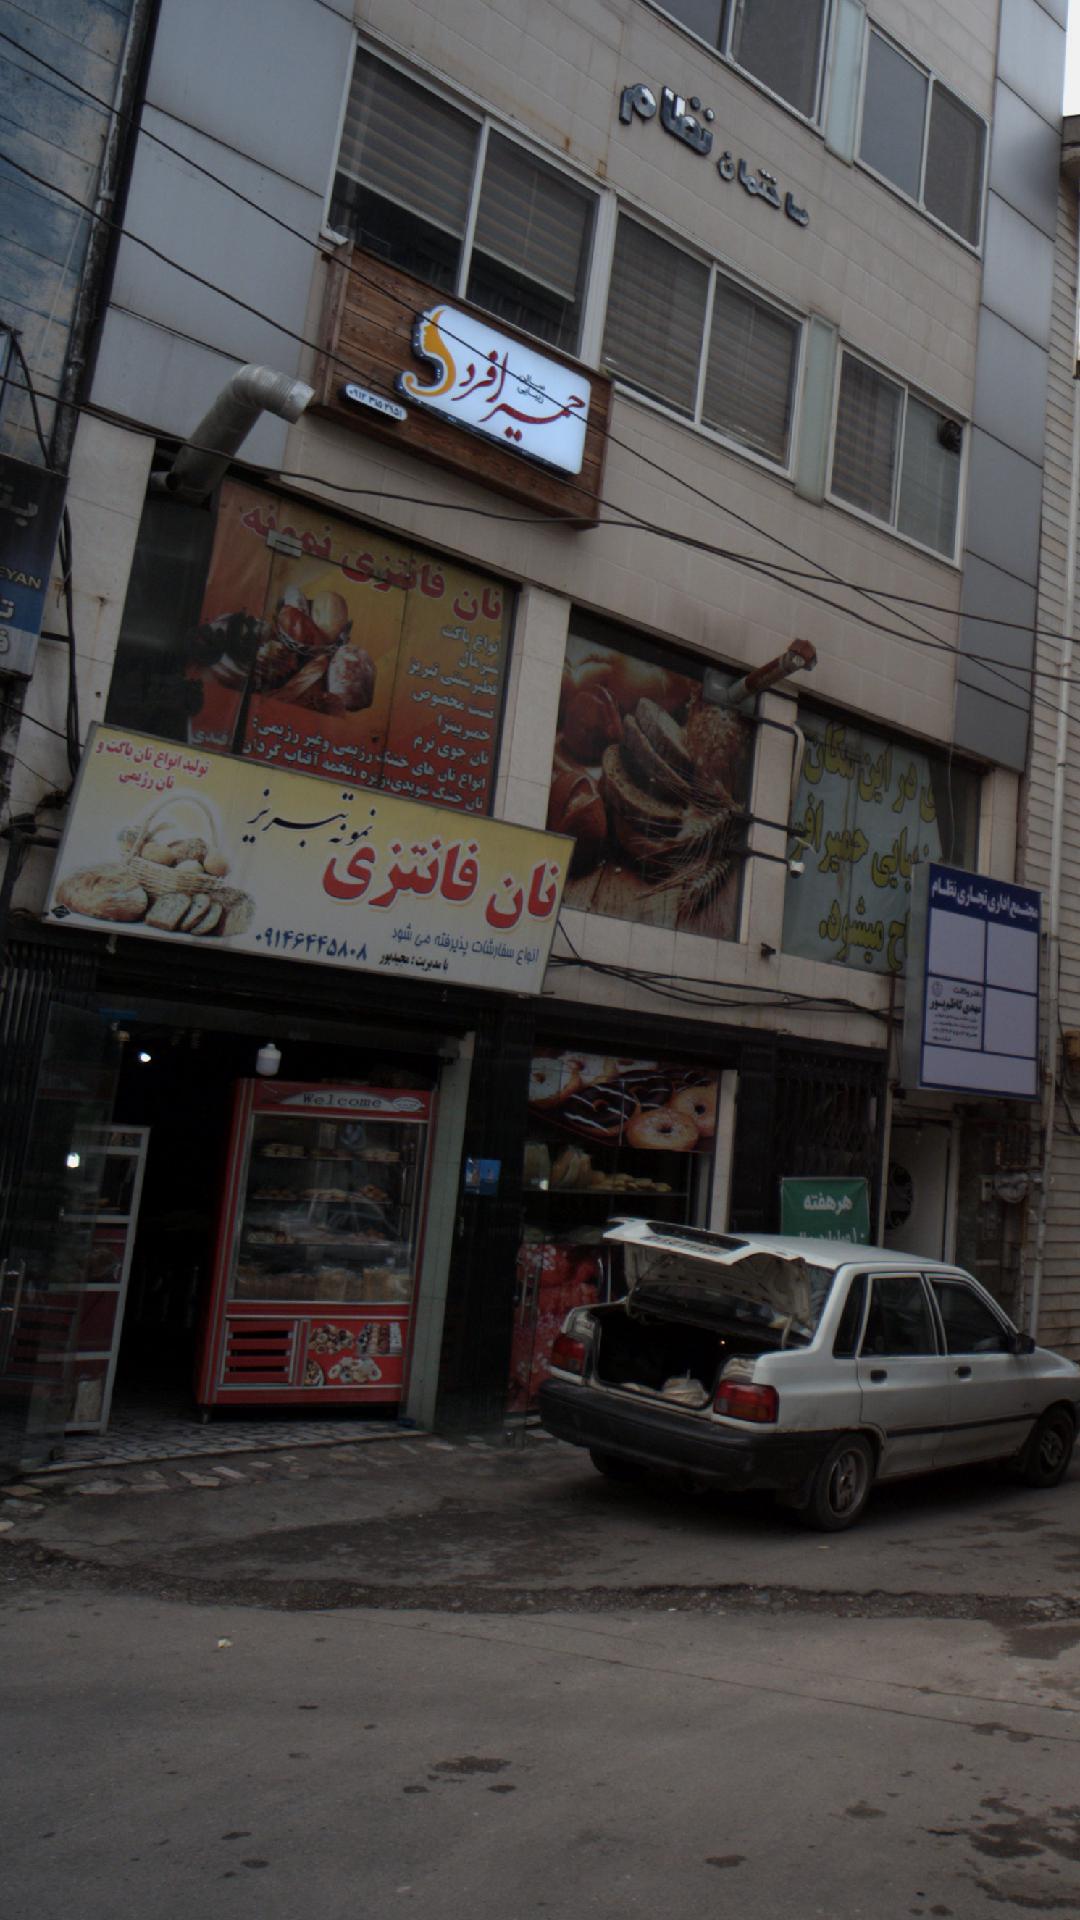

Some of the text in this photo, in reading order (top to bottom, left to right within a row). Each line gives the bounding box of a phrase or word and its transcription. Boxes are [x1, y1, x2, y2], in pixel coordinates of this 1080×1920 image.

[618, 83, 810, 228] ساختمان نظام
[340, 552, 445, 599] فانتزی
[453, 587, 503, 622] نان
[134, 745, 153, 764] نان
[153, 742, 183, 770] انواع
[469, 750, 489, 767] نان
[182, 756, 210, 778] تولید
[411, 762, 436, 777] های
[437, 766, 459, 783] نان
[155, 775, 174, 791] نان
[459, 773, 487, 791] انواع
[465, 796, 483, 811] نان
[322, 839, 560, 930] نان فانتزی
[931, 876, 1038, 922] مجتمع اداری تجاری نظام
[255, 927, 367, 961] ۰۹۱۴۶۴۴۵۸۰۸
[392, 922, 541, 966] انواع سفارشات پذیرفته می شود
[303, 1093, 382, 1108] Welcome
